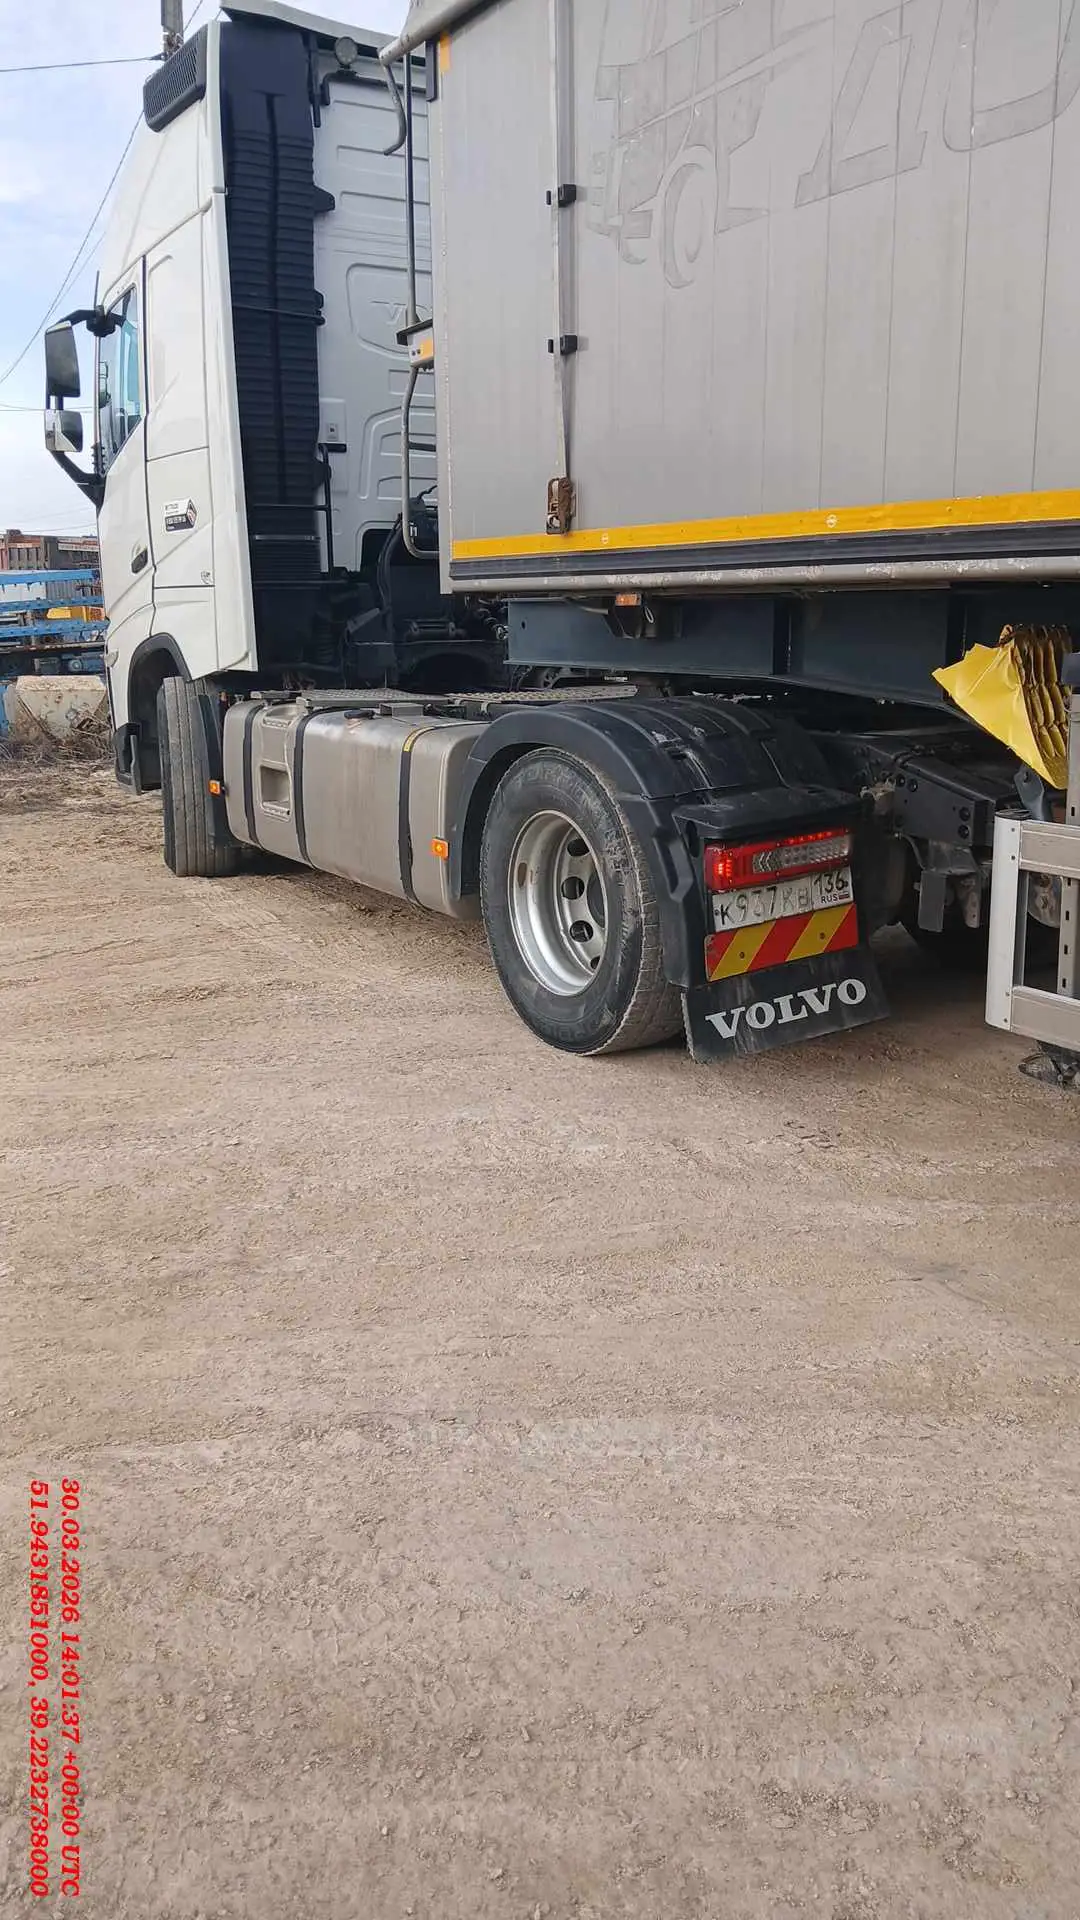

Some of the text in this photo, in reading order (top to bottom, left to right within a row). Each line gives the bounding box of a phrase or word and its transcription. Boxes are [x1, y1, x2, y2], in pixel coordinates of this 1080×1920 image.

[813, 871, 846, 896] 136
[820, 894, 838, 904] RUS
[705, 978, 867, 1039] VOLVO
